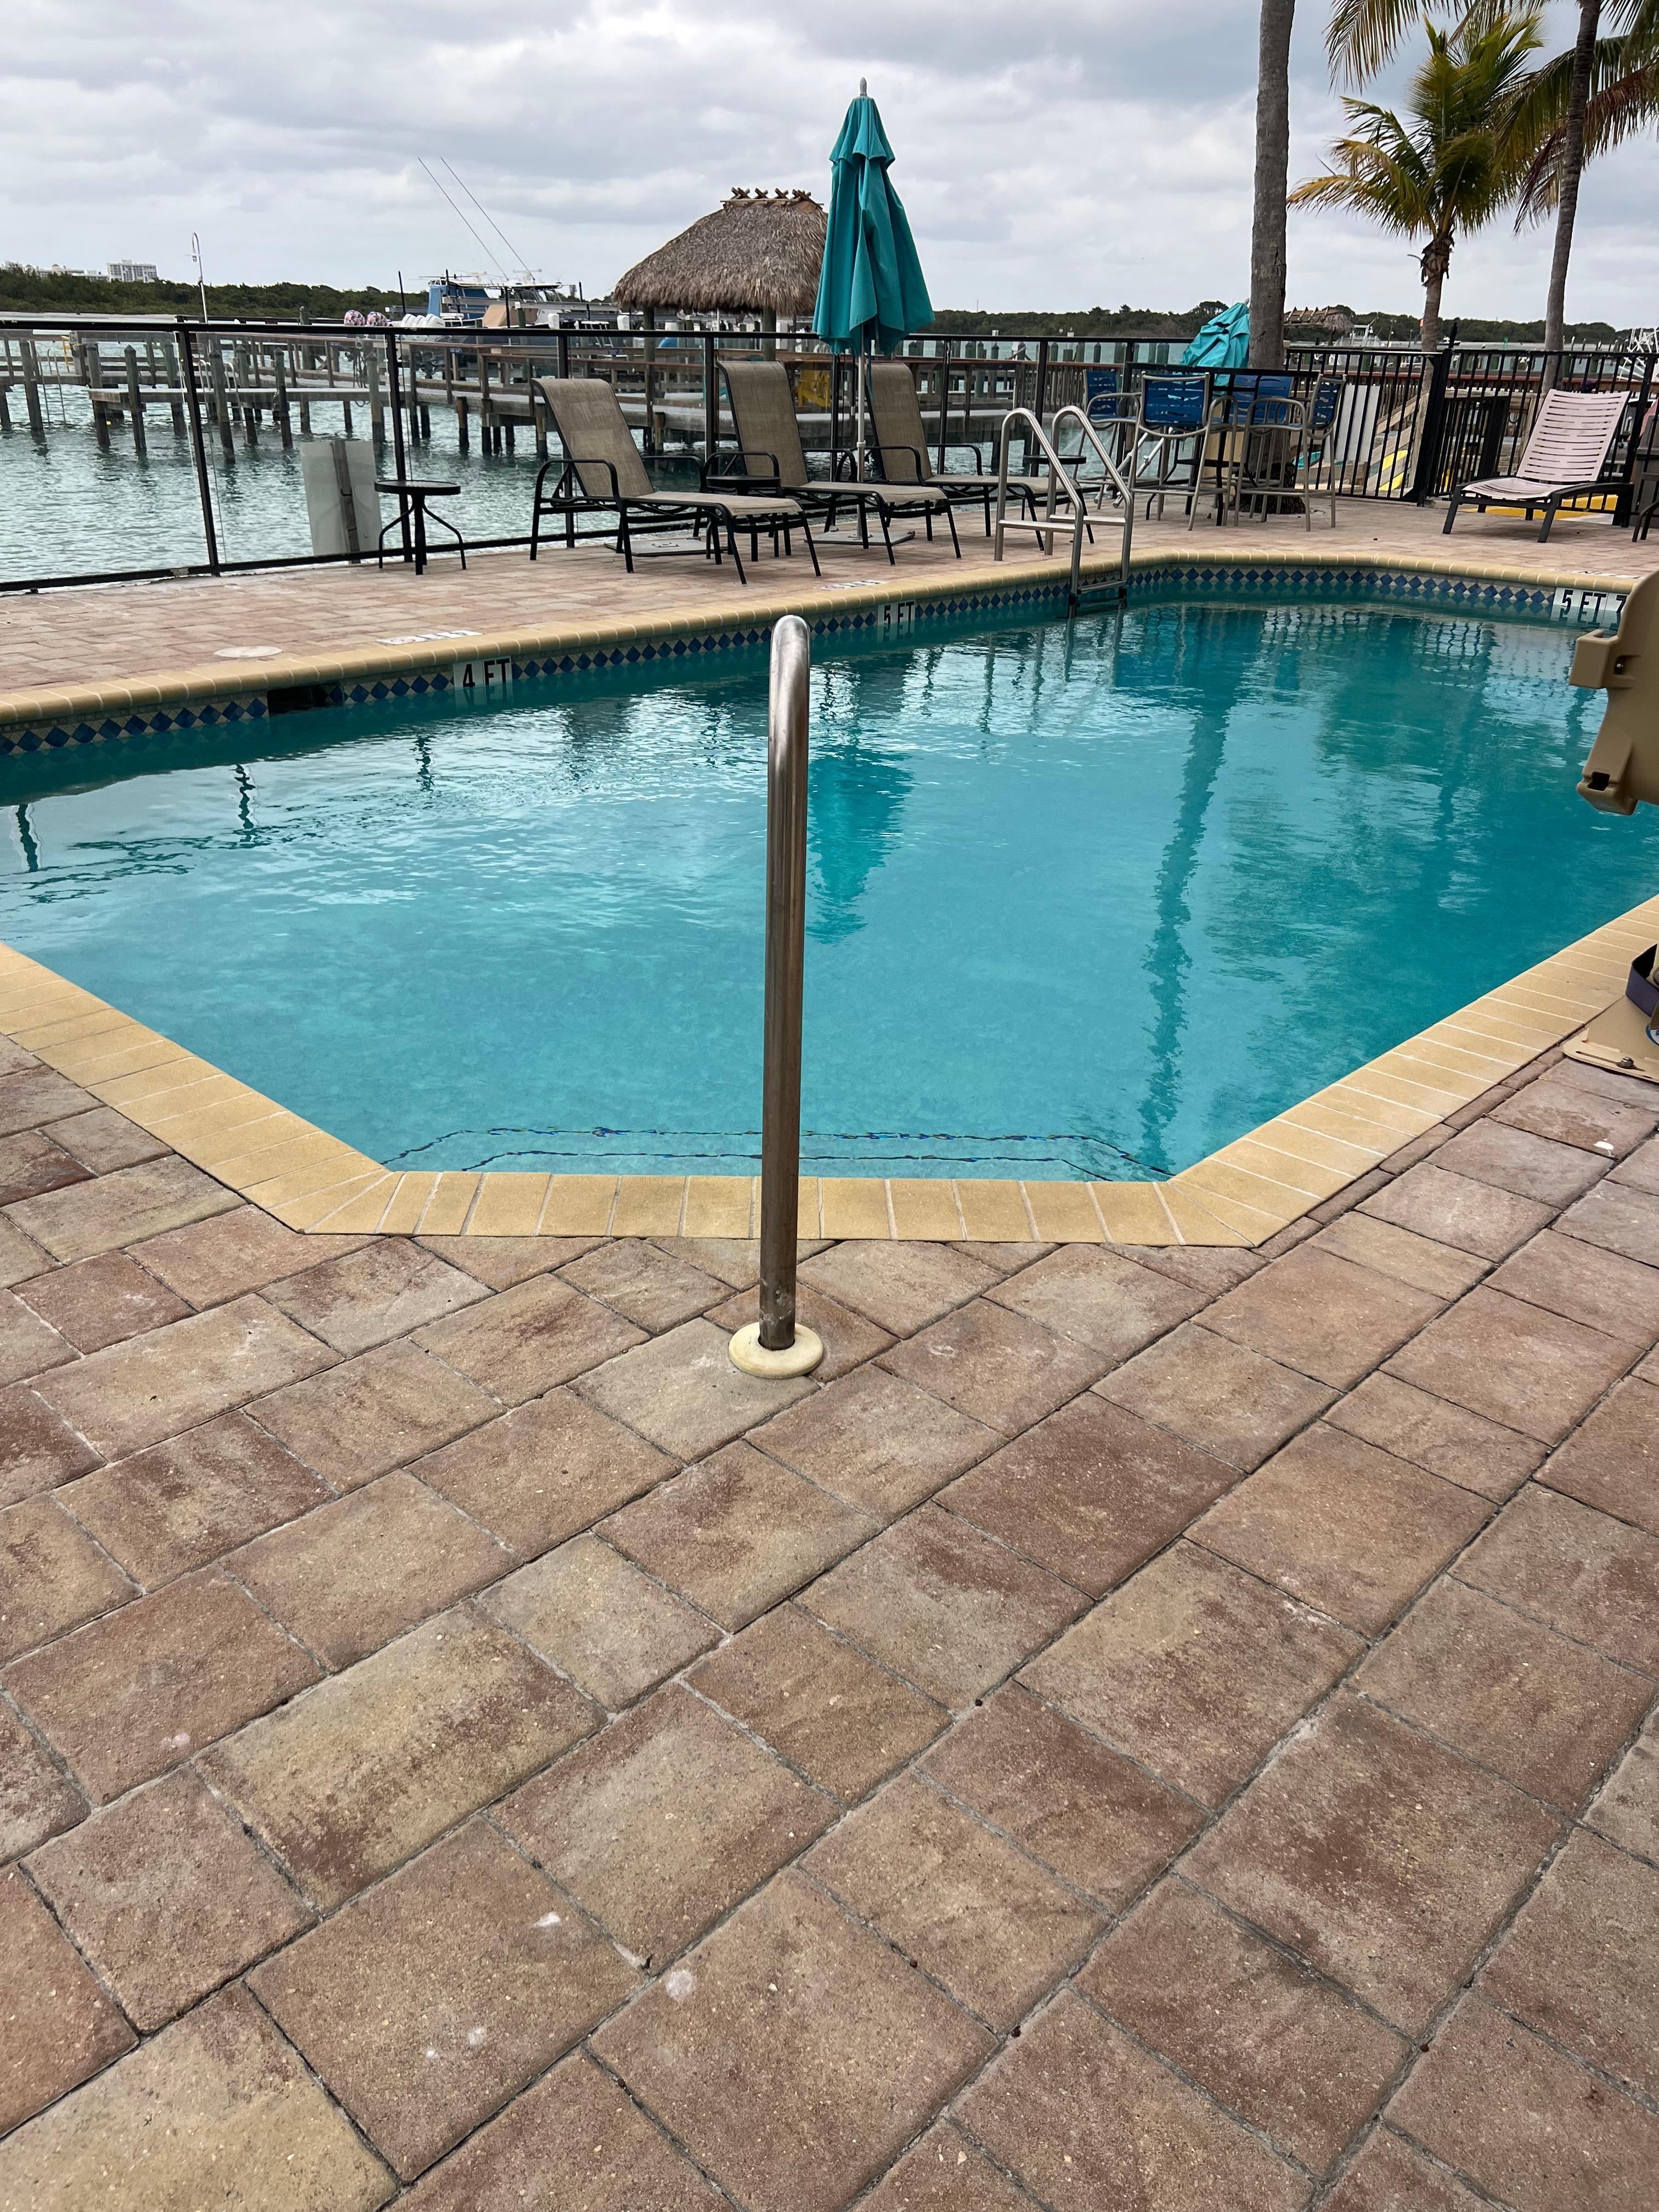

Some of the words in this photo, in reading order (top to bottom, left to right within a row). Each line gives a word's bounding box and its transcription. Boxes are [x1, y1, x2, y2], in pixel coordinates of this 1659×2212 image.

[1562, 589, 1574, 608] 5
[1579, 591, 1607, 611] FT
[884, 605, 891, 624] 5
[897, 601, 915, 623] FT
[463, 663, 476, 687] 4
[483, 658, 510, 686] FT
